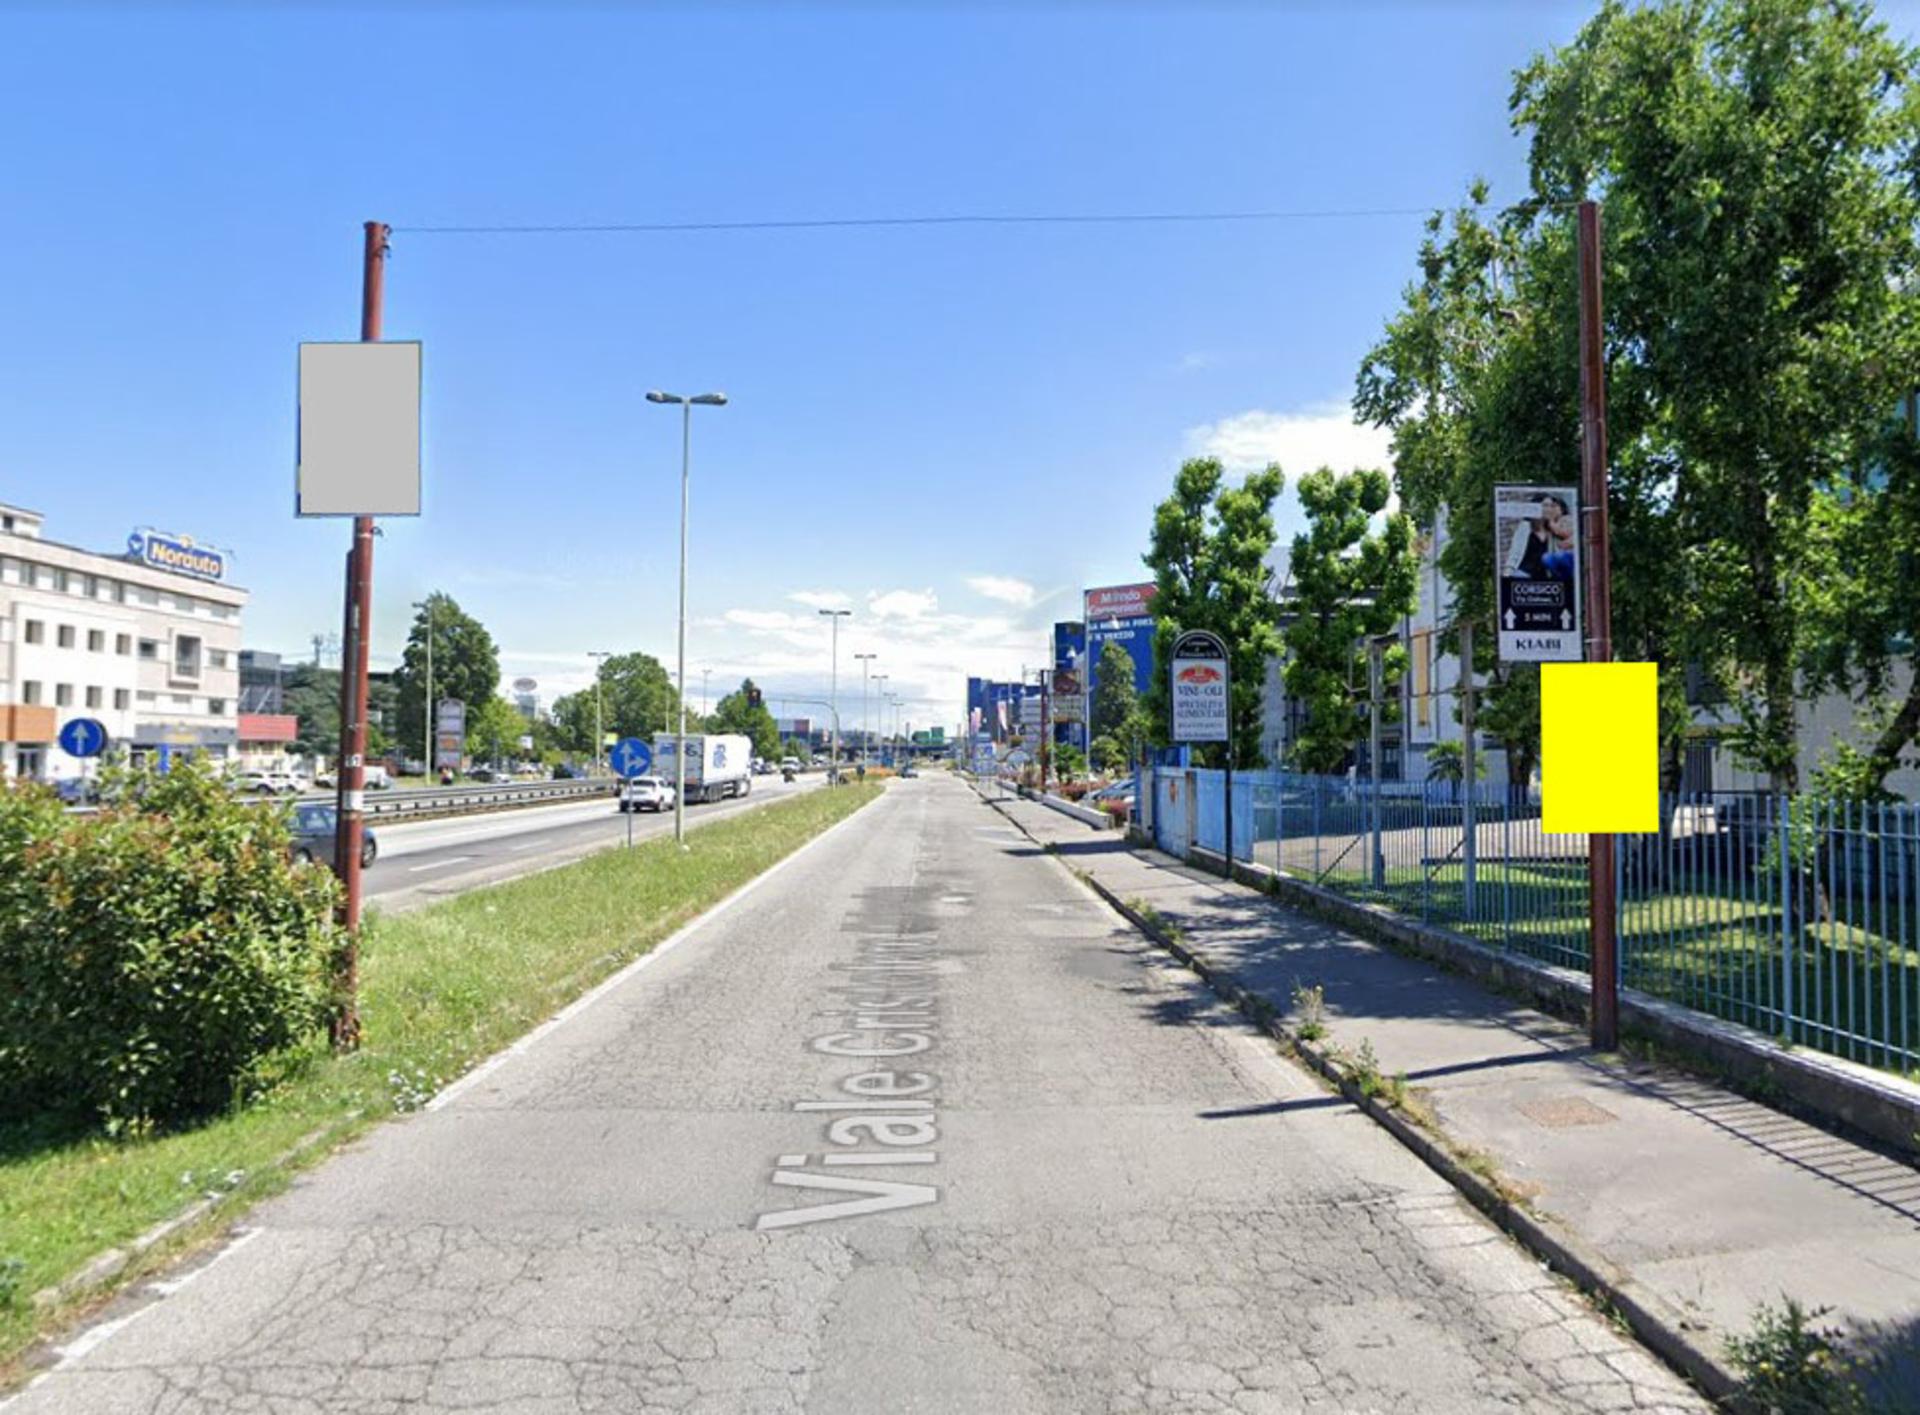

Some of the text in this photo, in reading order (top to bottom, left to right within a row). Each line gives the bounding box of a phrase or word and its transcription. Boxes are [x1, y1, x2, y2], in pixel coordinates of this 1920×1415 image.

[152, 542, 220, 575] Norauto
[1514, 584, 1560, 594] CORSICO
[1516, 638, 1562, 650] KIABI
[1204, 684, 1223, 696] OLI
